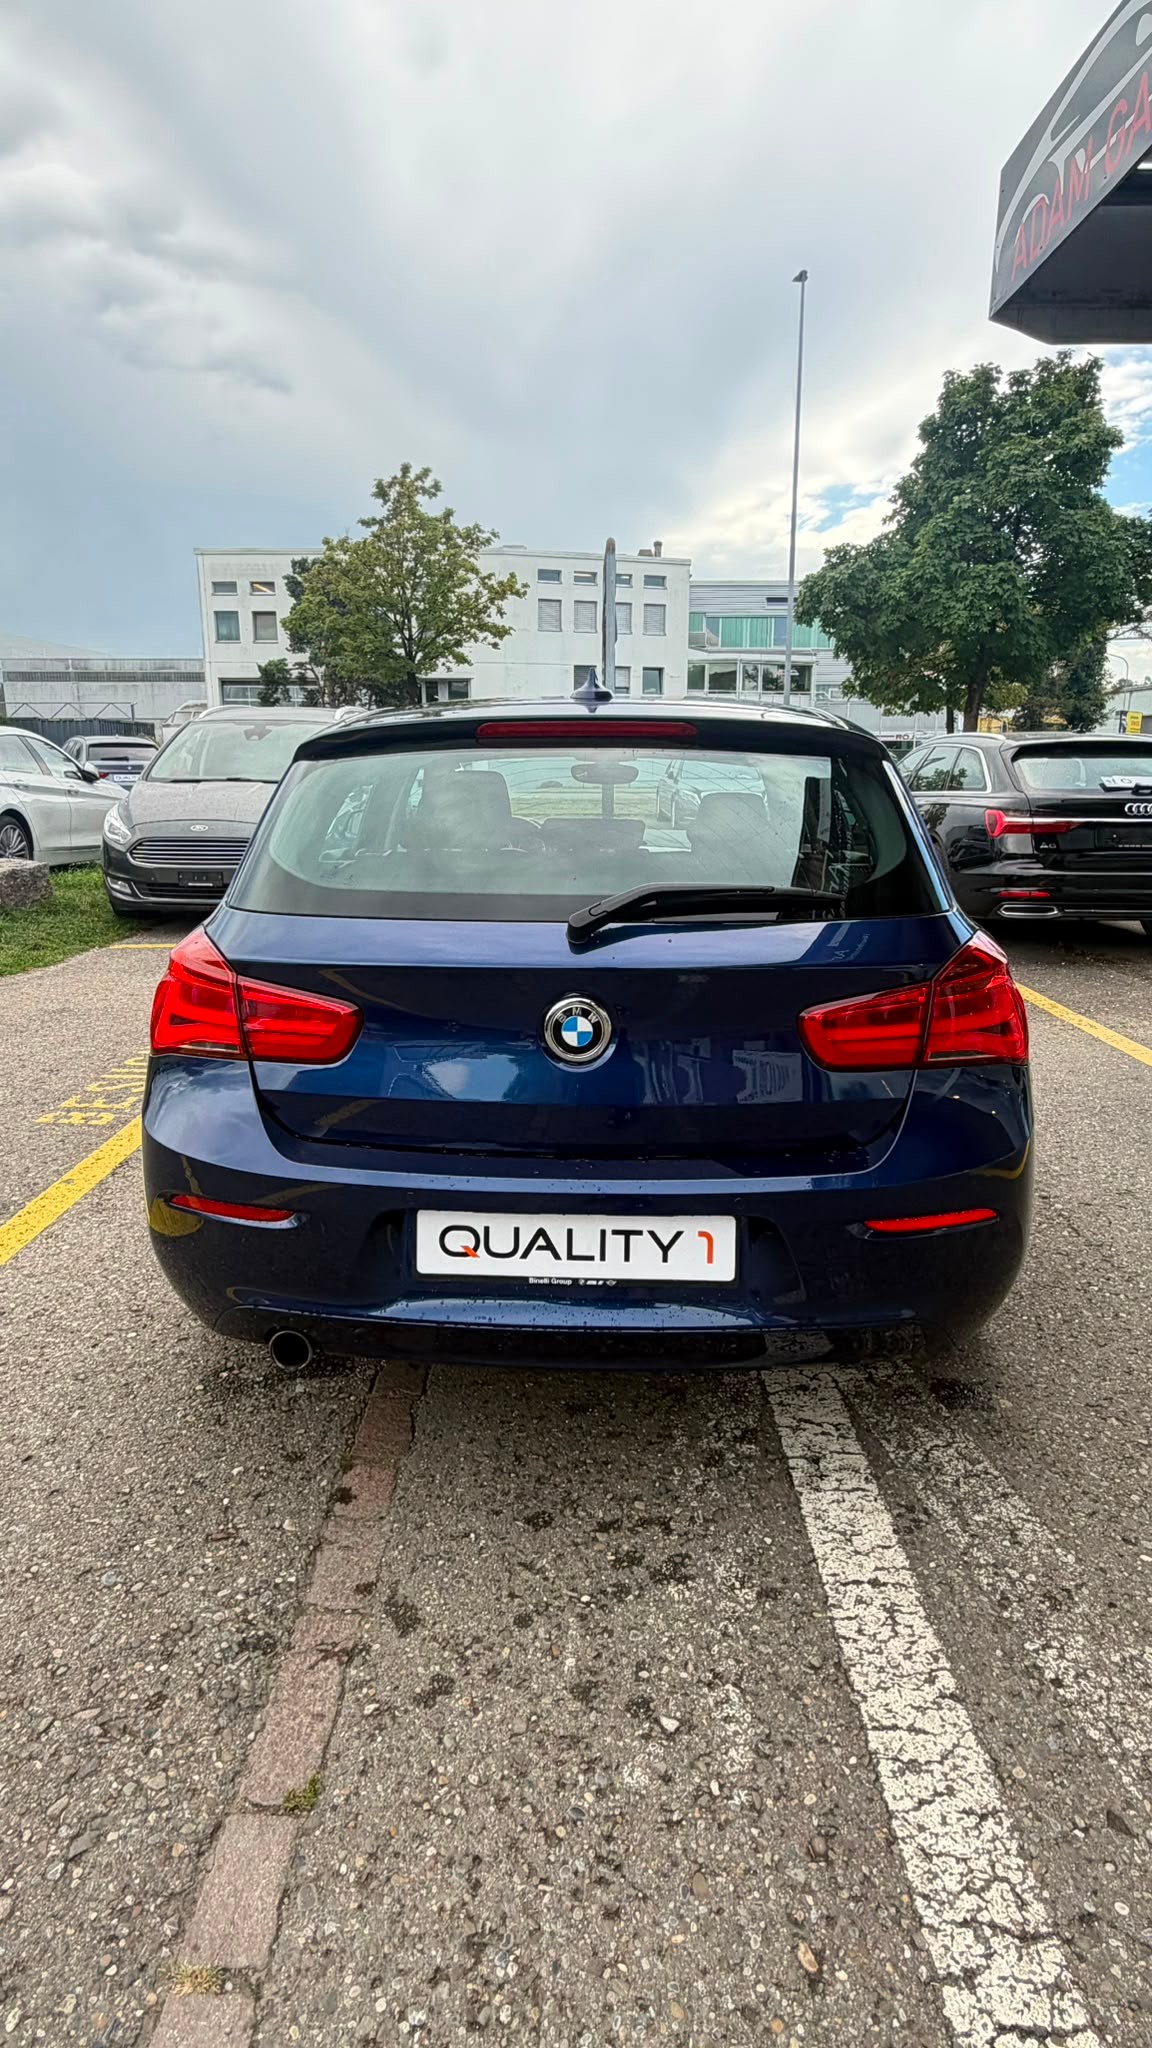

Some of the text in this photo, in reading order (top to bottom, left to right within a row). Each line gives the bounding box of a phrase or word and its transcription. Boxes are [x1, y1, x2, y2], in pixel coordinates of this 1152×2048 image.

[1010, 136, 1093, 282] ADAM
[556, 1007, 598, 1023] BMW
[438, 1224, 714, 1265] QUALITY 1
[551, 1277, 572, 1285] Group
